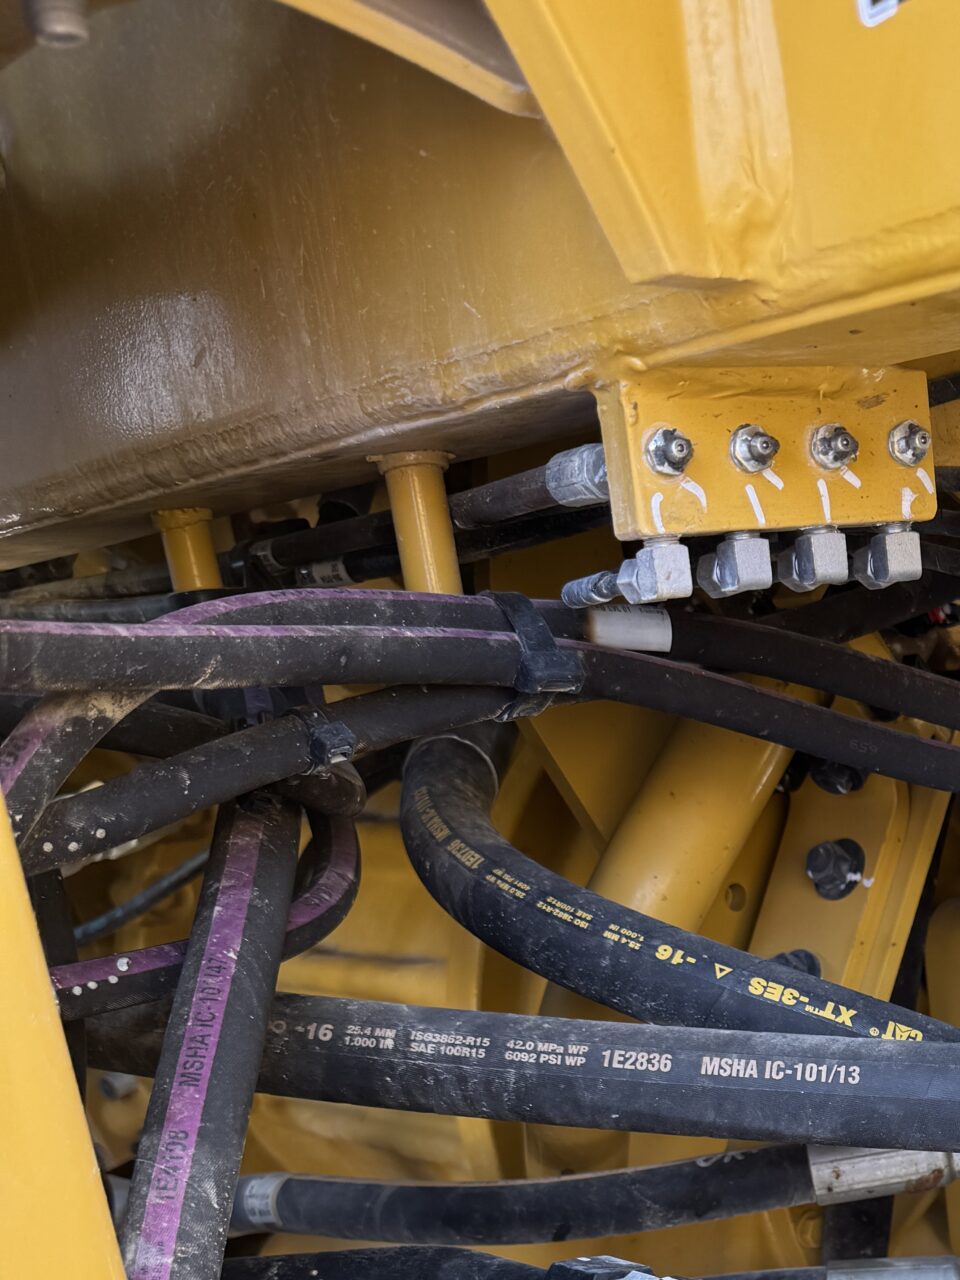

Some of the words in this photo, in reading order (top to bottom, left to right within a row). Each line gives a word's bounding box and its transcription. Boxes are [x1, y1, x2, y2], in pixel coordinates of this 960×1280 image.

[655, 943, 697, 965] -16
[346, 1025, 372, 1036] 25.4
[374, 1027, 396, 1038] MM
[344, 1036, 376, 1048] 1.000
[409, 1042, 436, 1055] SAE
[439, 1044, 486, 1058] 100R15
[506, 1039, 535, 1051] 42.0
[536, 1042, 564, 1054] MPa
[567, 1045, 589, 1055] WP
[178, 1030, 212, 1089] MSHA
[504, 1051, 537, 1063] 6092
[539, 1053, 562, 1066] PSI
[564, 1055, 587, 1067] WP
[601, 1049, 673, 1073] 1E2836
[700, 1056, 759, 1079] MSHA
[764, 1060, 861, 1085] IC-101/13
